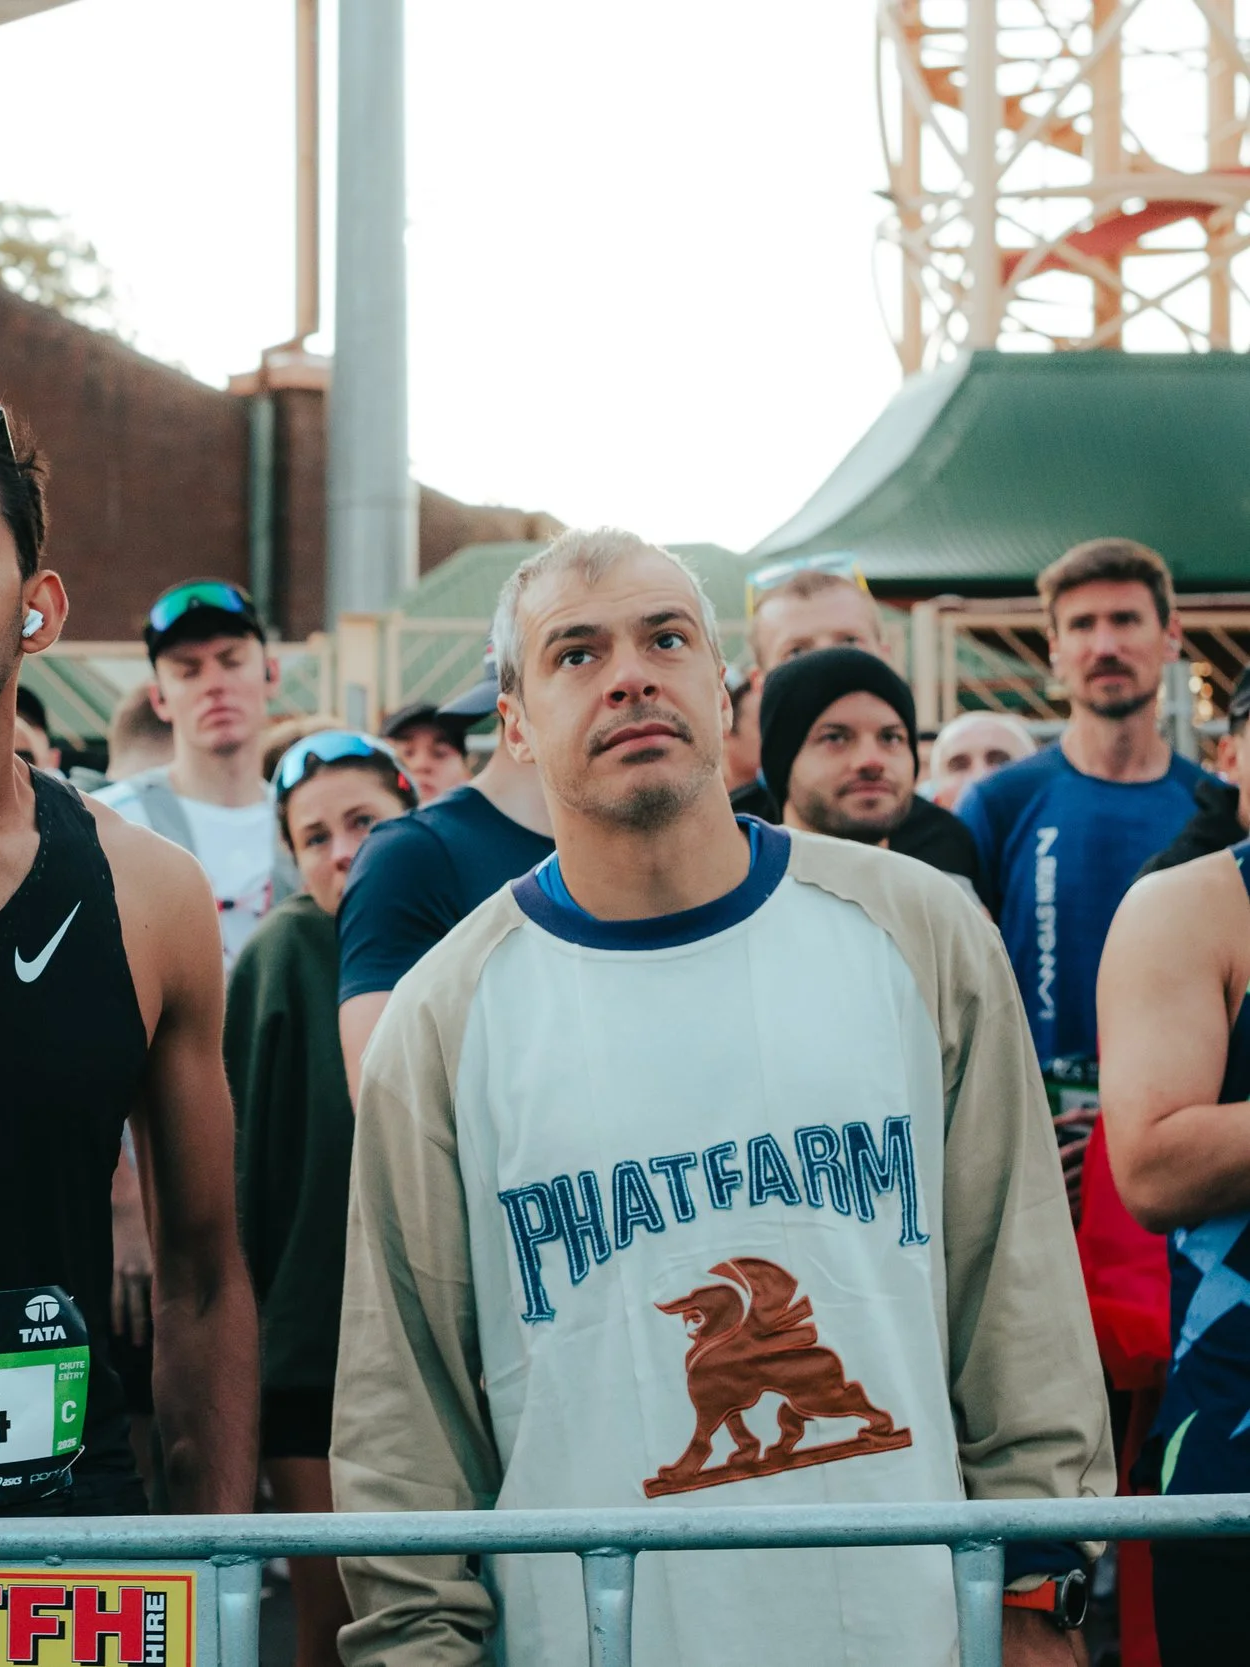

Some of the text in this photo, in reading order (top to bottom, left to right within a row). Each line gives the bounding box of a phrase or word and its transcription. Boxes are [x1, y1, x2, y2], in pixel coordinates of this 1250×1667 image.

[18, 1325, 67, 1343] TATA
[59, 1360, 85, 1371] CHUTE
[58, 1371, 85, 1381] ENTRY
[61, 1400, 77, 1424] C
[145, 1593, 166, 1664] HIRE
